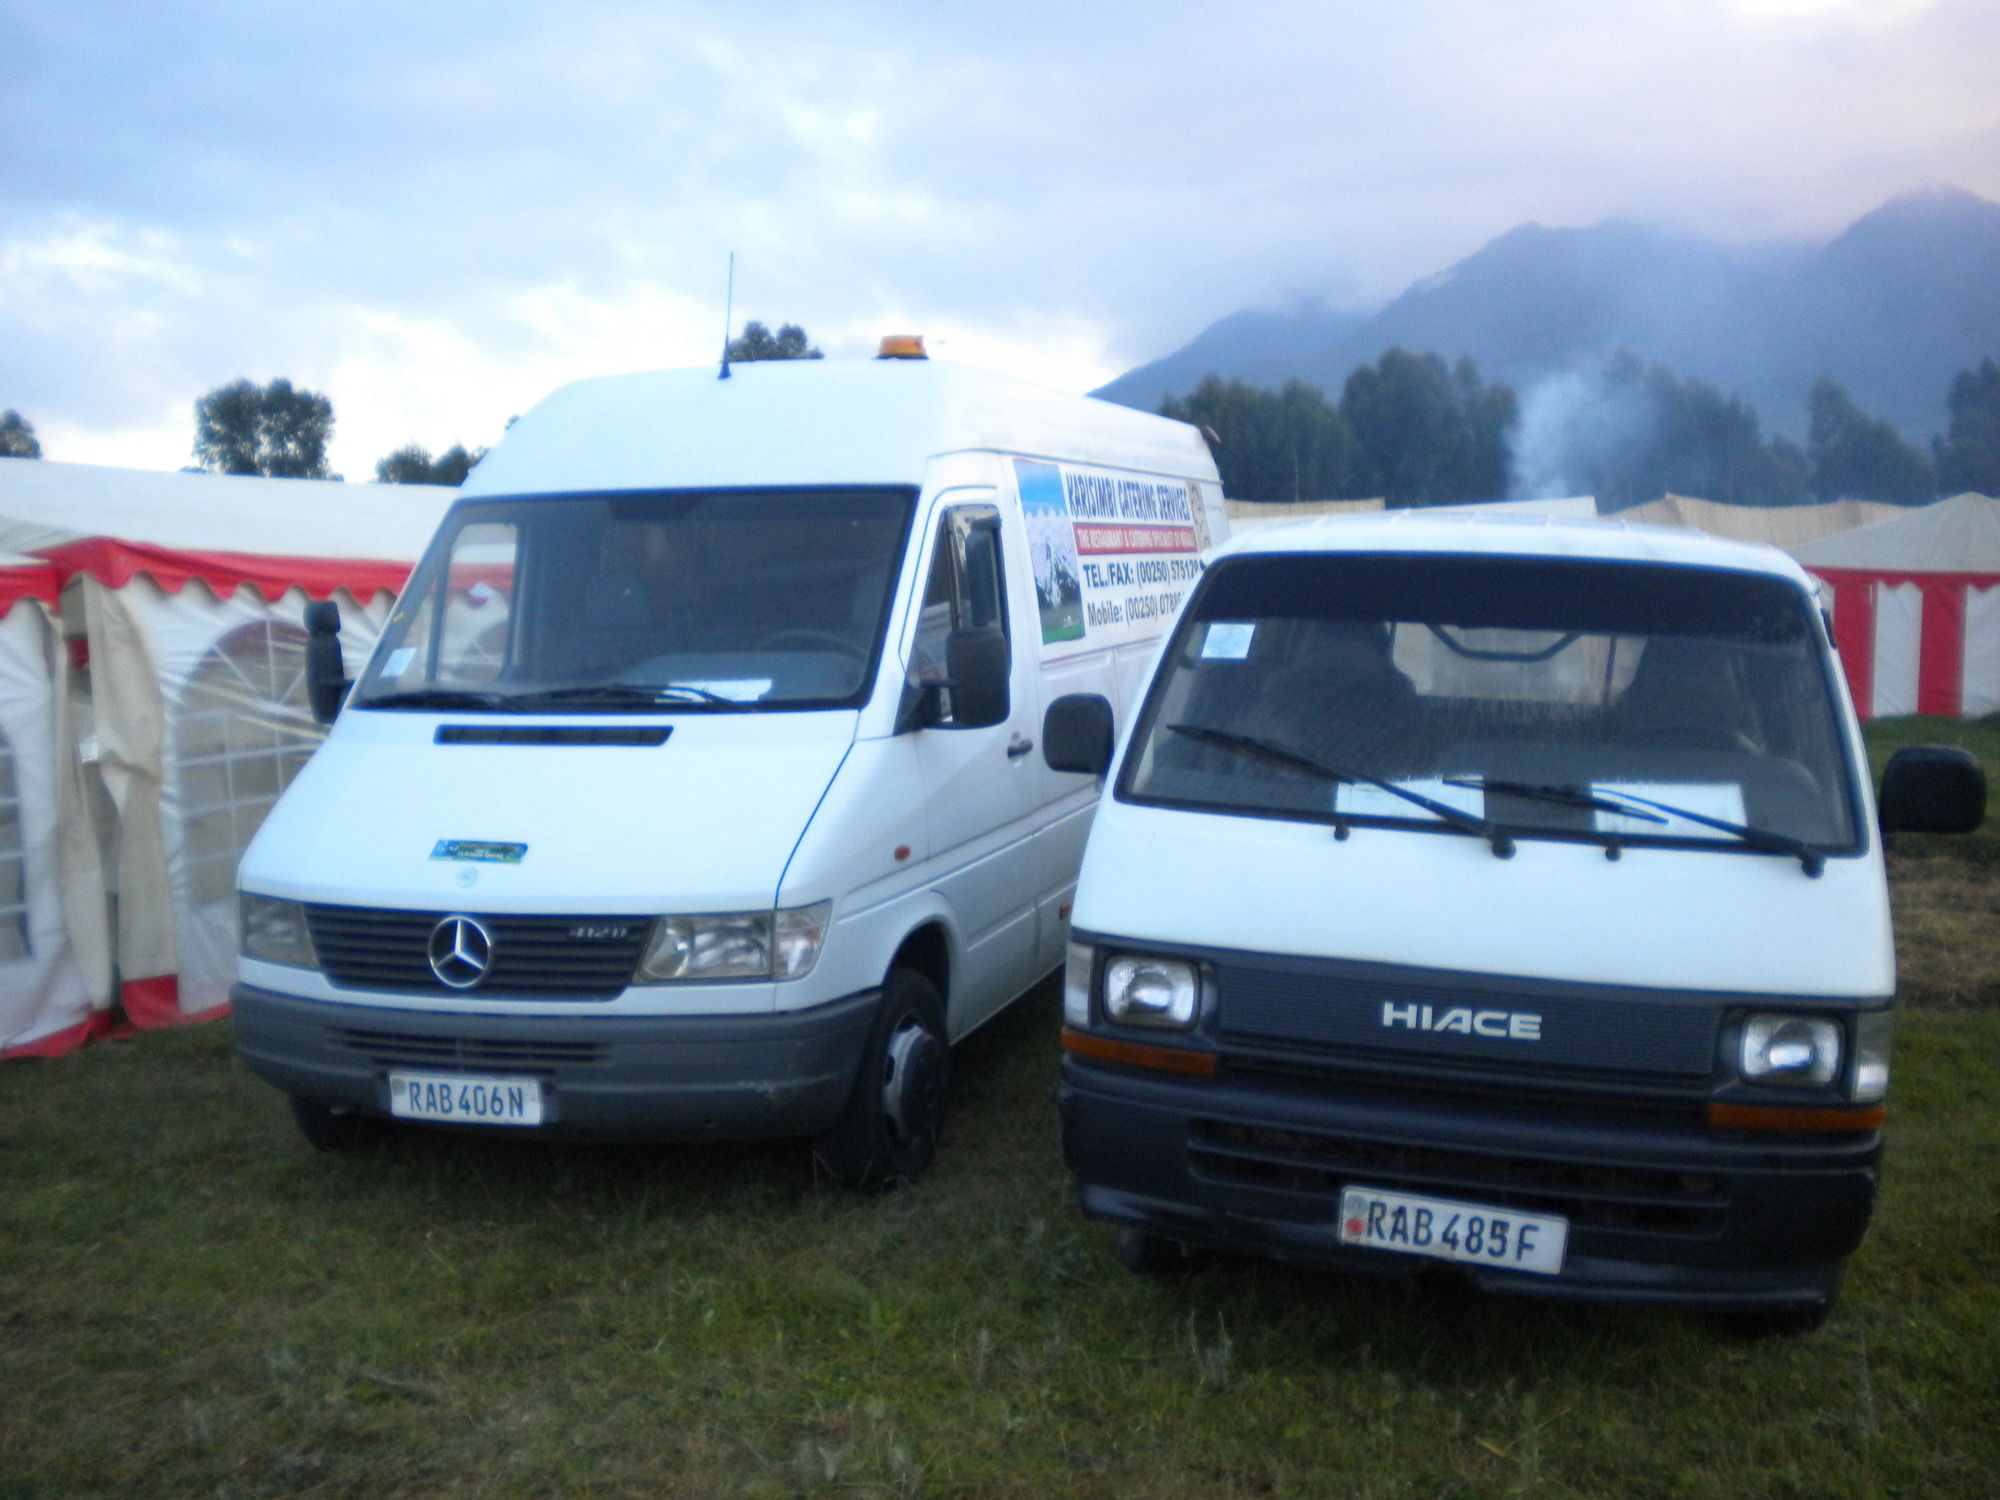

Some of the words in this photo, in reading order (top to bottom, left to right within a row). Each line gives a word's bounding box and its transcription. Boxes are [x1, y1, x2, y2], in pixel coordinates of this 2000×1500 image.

[1118, 479, 1157, 521] CATERING
[1082, 561, 1134, 588] TEL./FAX:
[1136, 560, 1170, 589] (00250)
[1087, 600, 1123, 627] Mobile:
[1125, 596, 1158, 625] (00250)
[1383, 1001, 1542, 1041] HIACE
